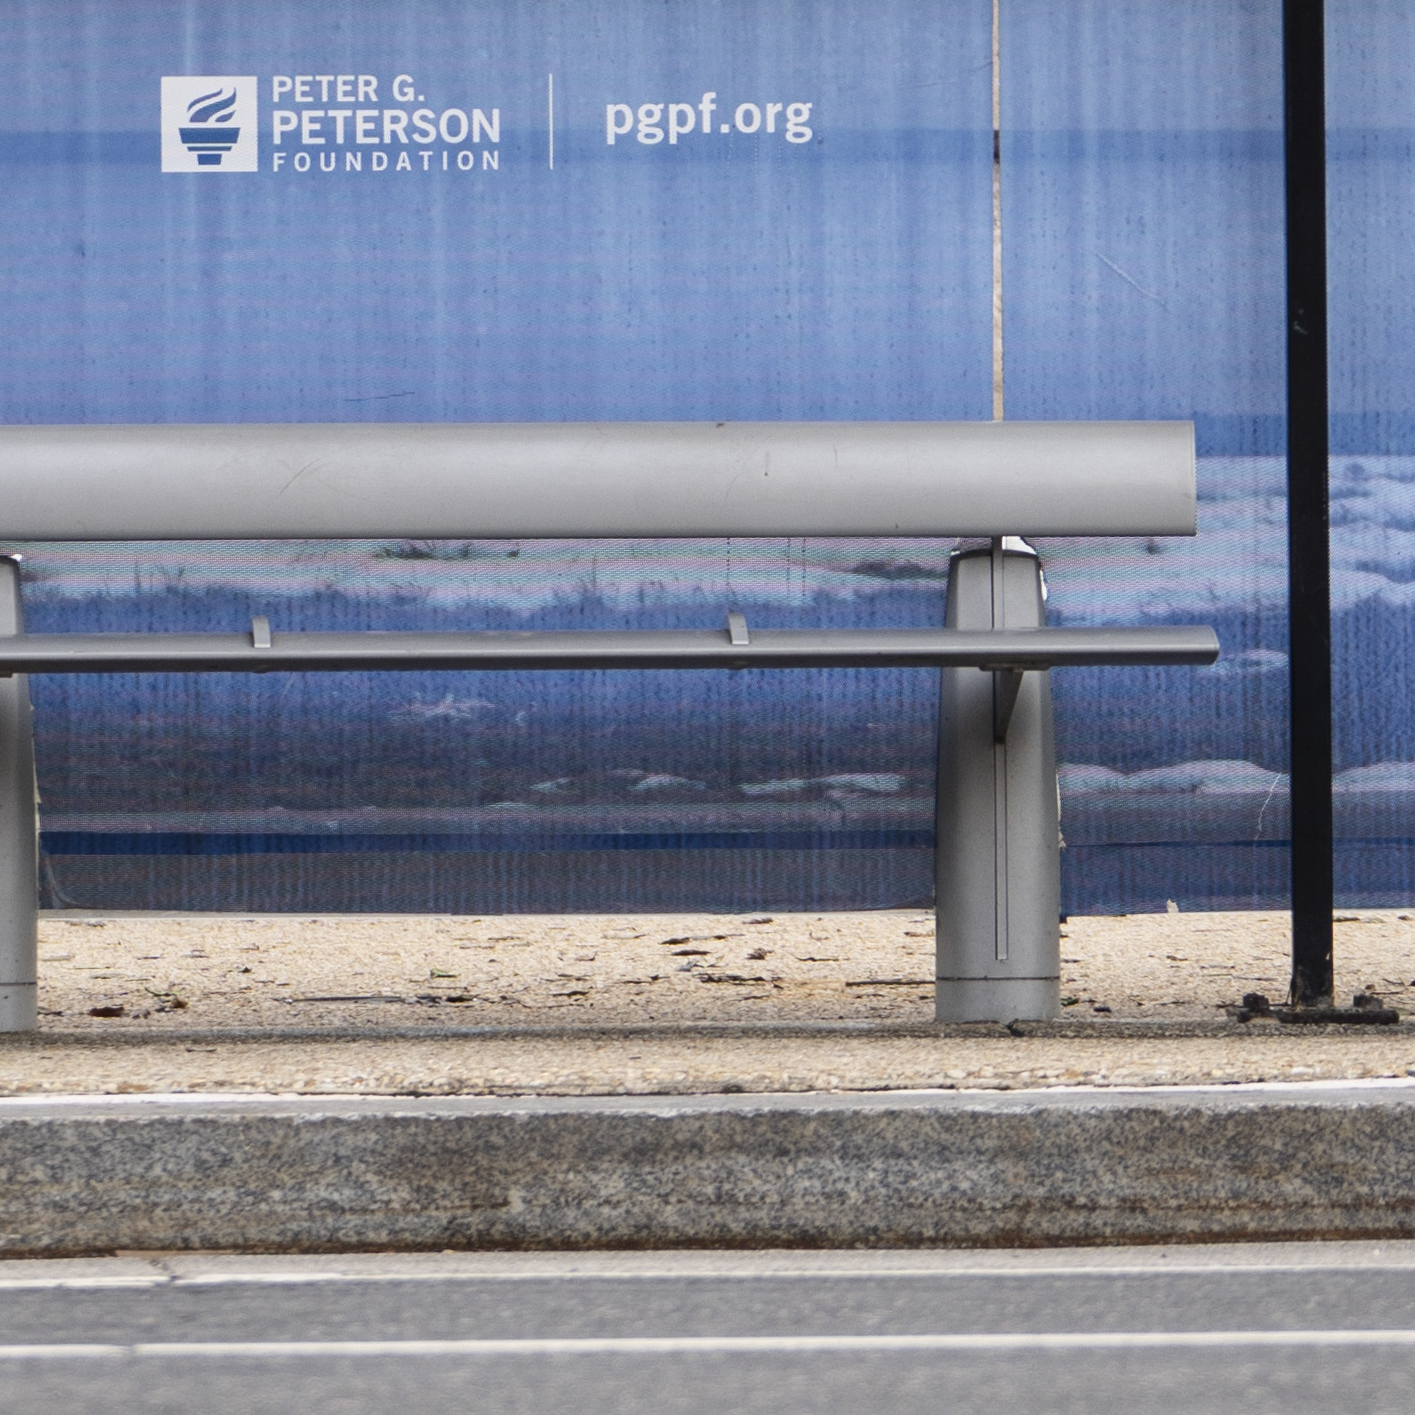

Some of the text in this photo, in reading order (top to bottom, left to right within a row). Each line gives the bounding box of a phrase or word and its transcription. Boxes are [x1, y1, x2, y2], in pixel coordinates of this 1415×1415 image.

[272, 74, 426, 104] PETER G.
[272, 107, 501, 146] PETERSON
[605, 92, 815, 145] pgpf.org
[272, 150, 501, 173] FOUNDATION
